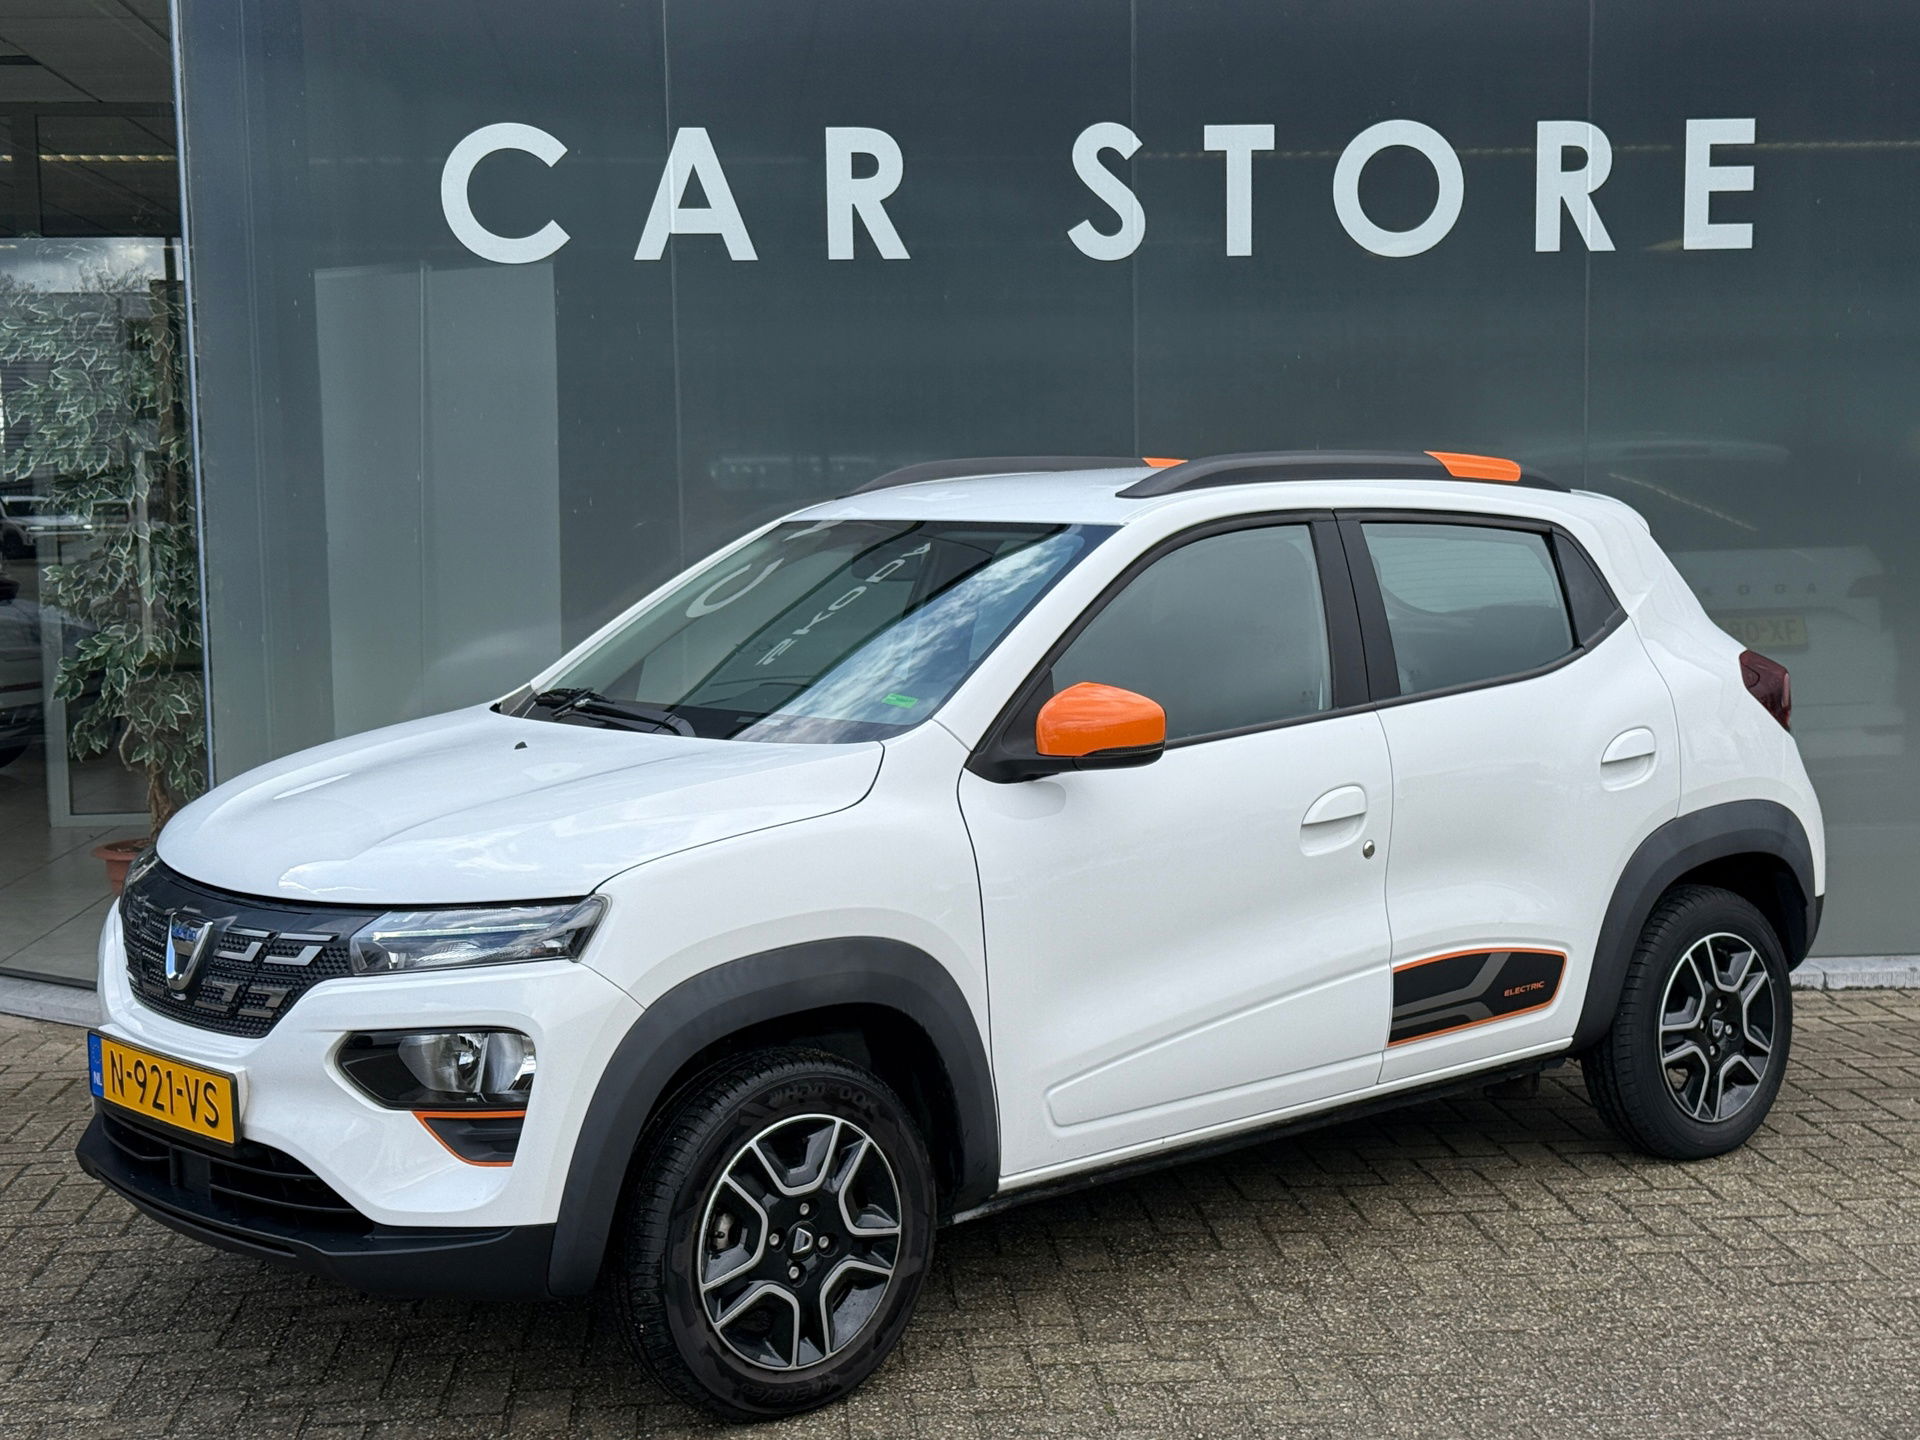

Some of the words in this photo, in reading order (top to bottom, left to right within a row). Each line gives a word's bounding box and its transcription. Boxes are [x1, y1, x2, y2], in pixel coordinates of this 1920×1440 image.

[441, 122, 911, 264] CAR
[1067, 118, 1757, 261] STORE
[1504, 980, 1545, 997] ELECTRIC
[93, 1070, 102, 1087] NL
[110, 1050, 219, 1129] N-921-VS
